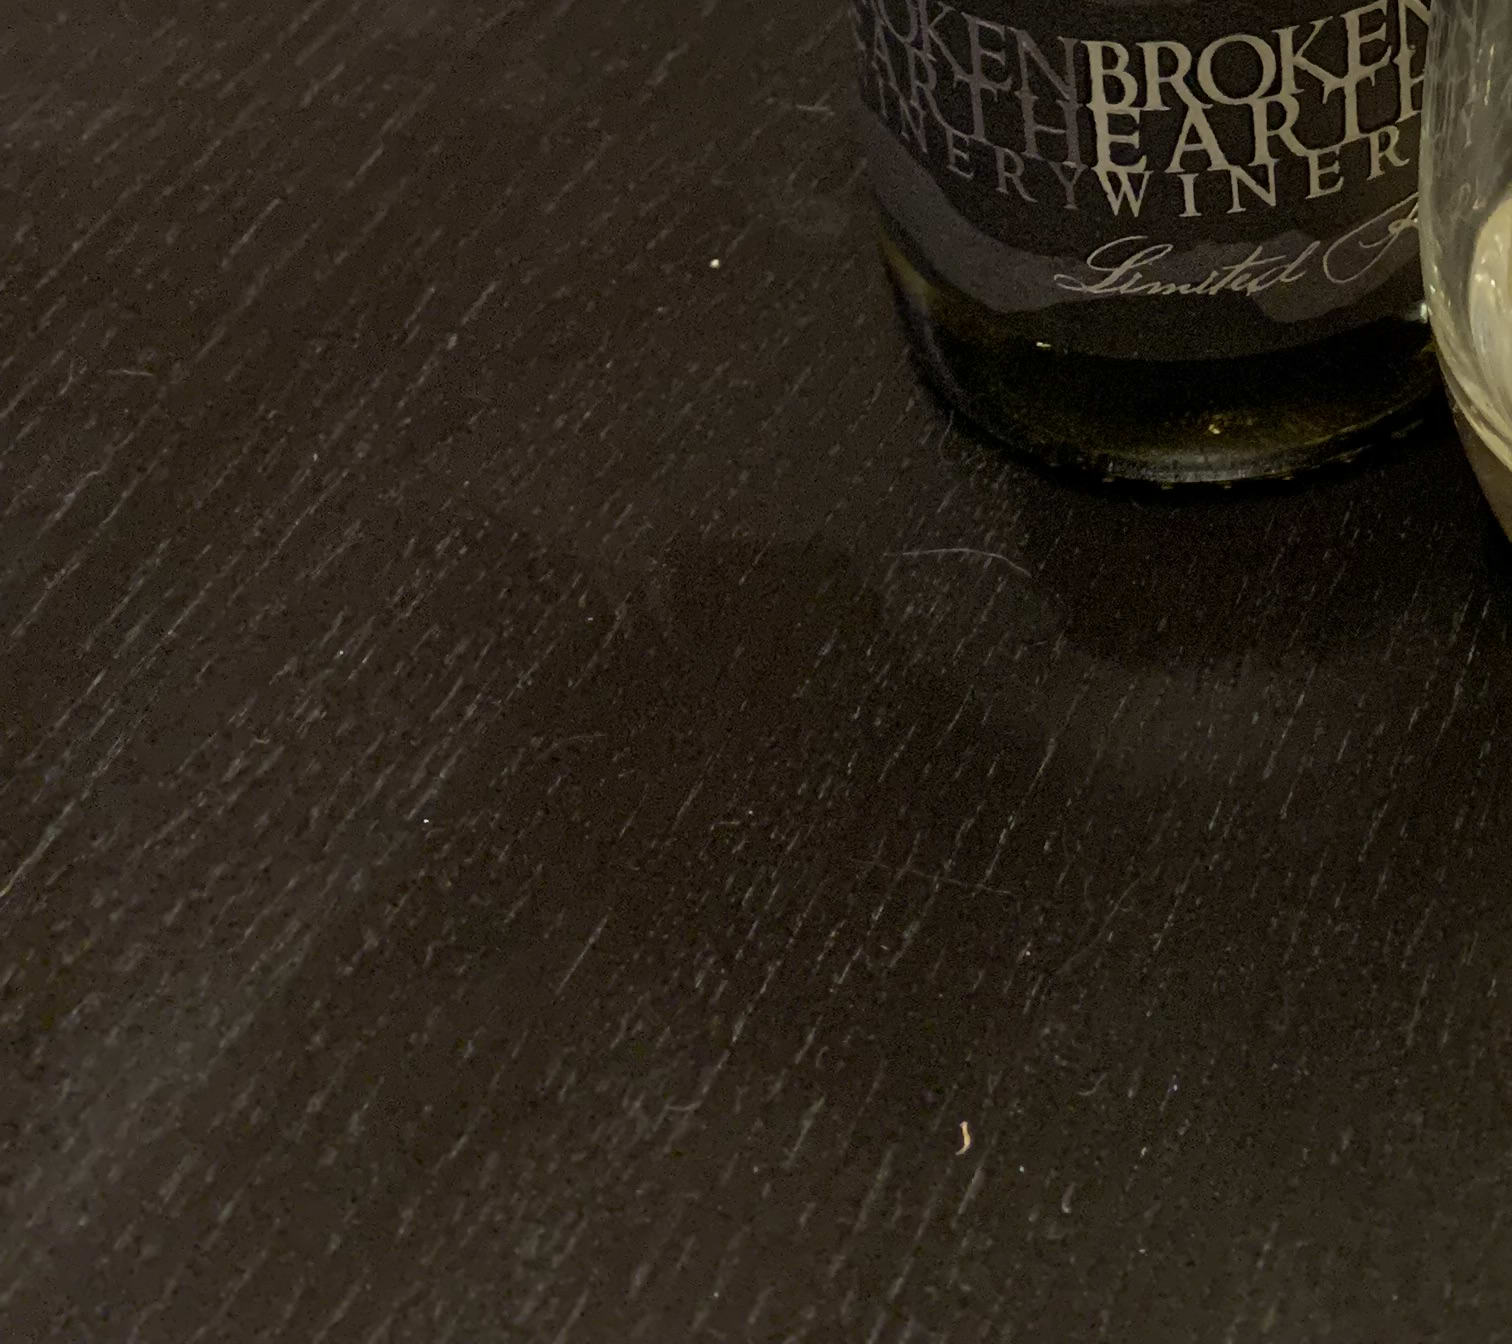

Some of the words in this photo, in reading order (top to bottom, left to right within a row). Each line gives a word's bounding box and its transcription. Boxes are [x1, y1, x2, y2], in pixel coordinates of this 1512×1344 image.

[864, 60, 1092, 211] INERY
[1091, 125, 1411, 217] WINER
[1053, 234, 1321, 297] Limited
